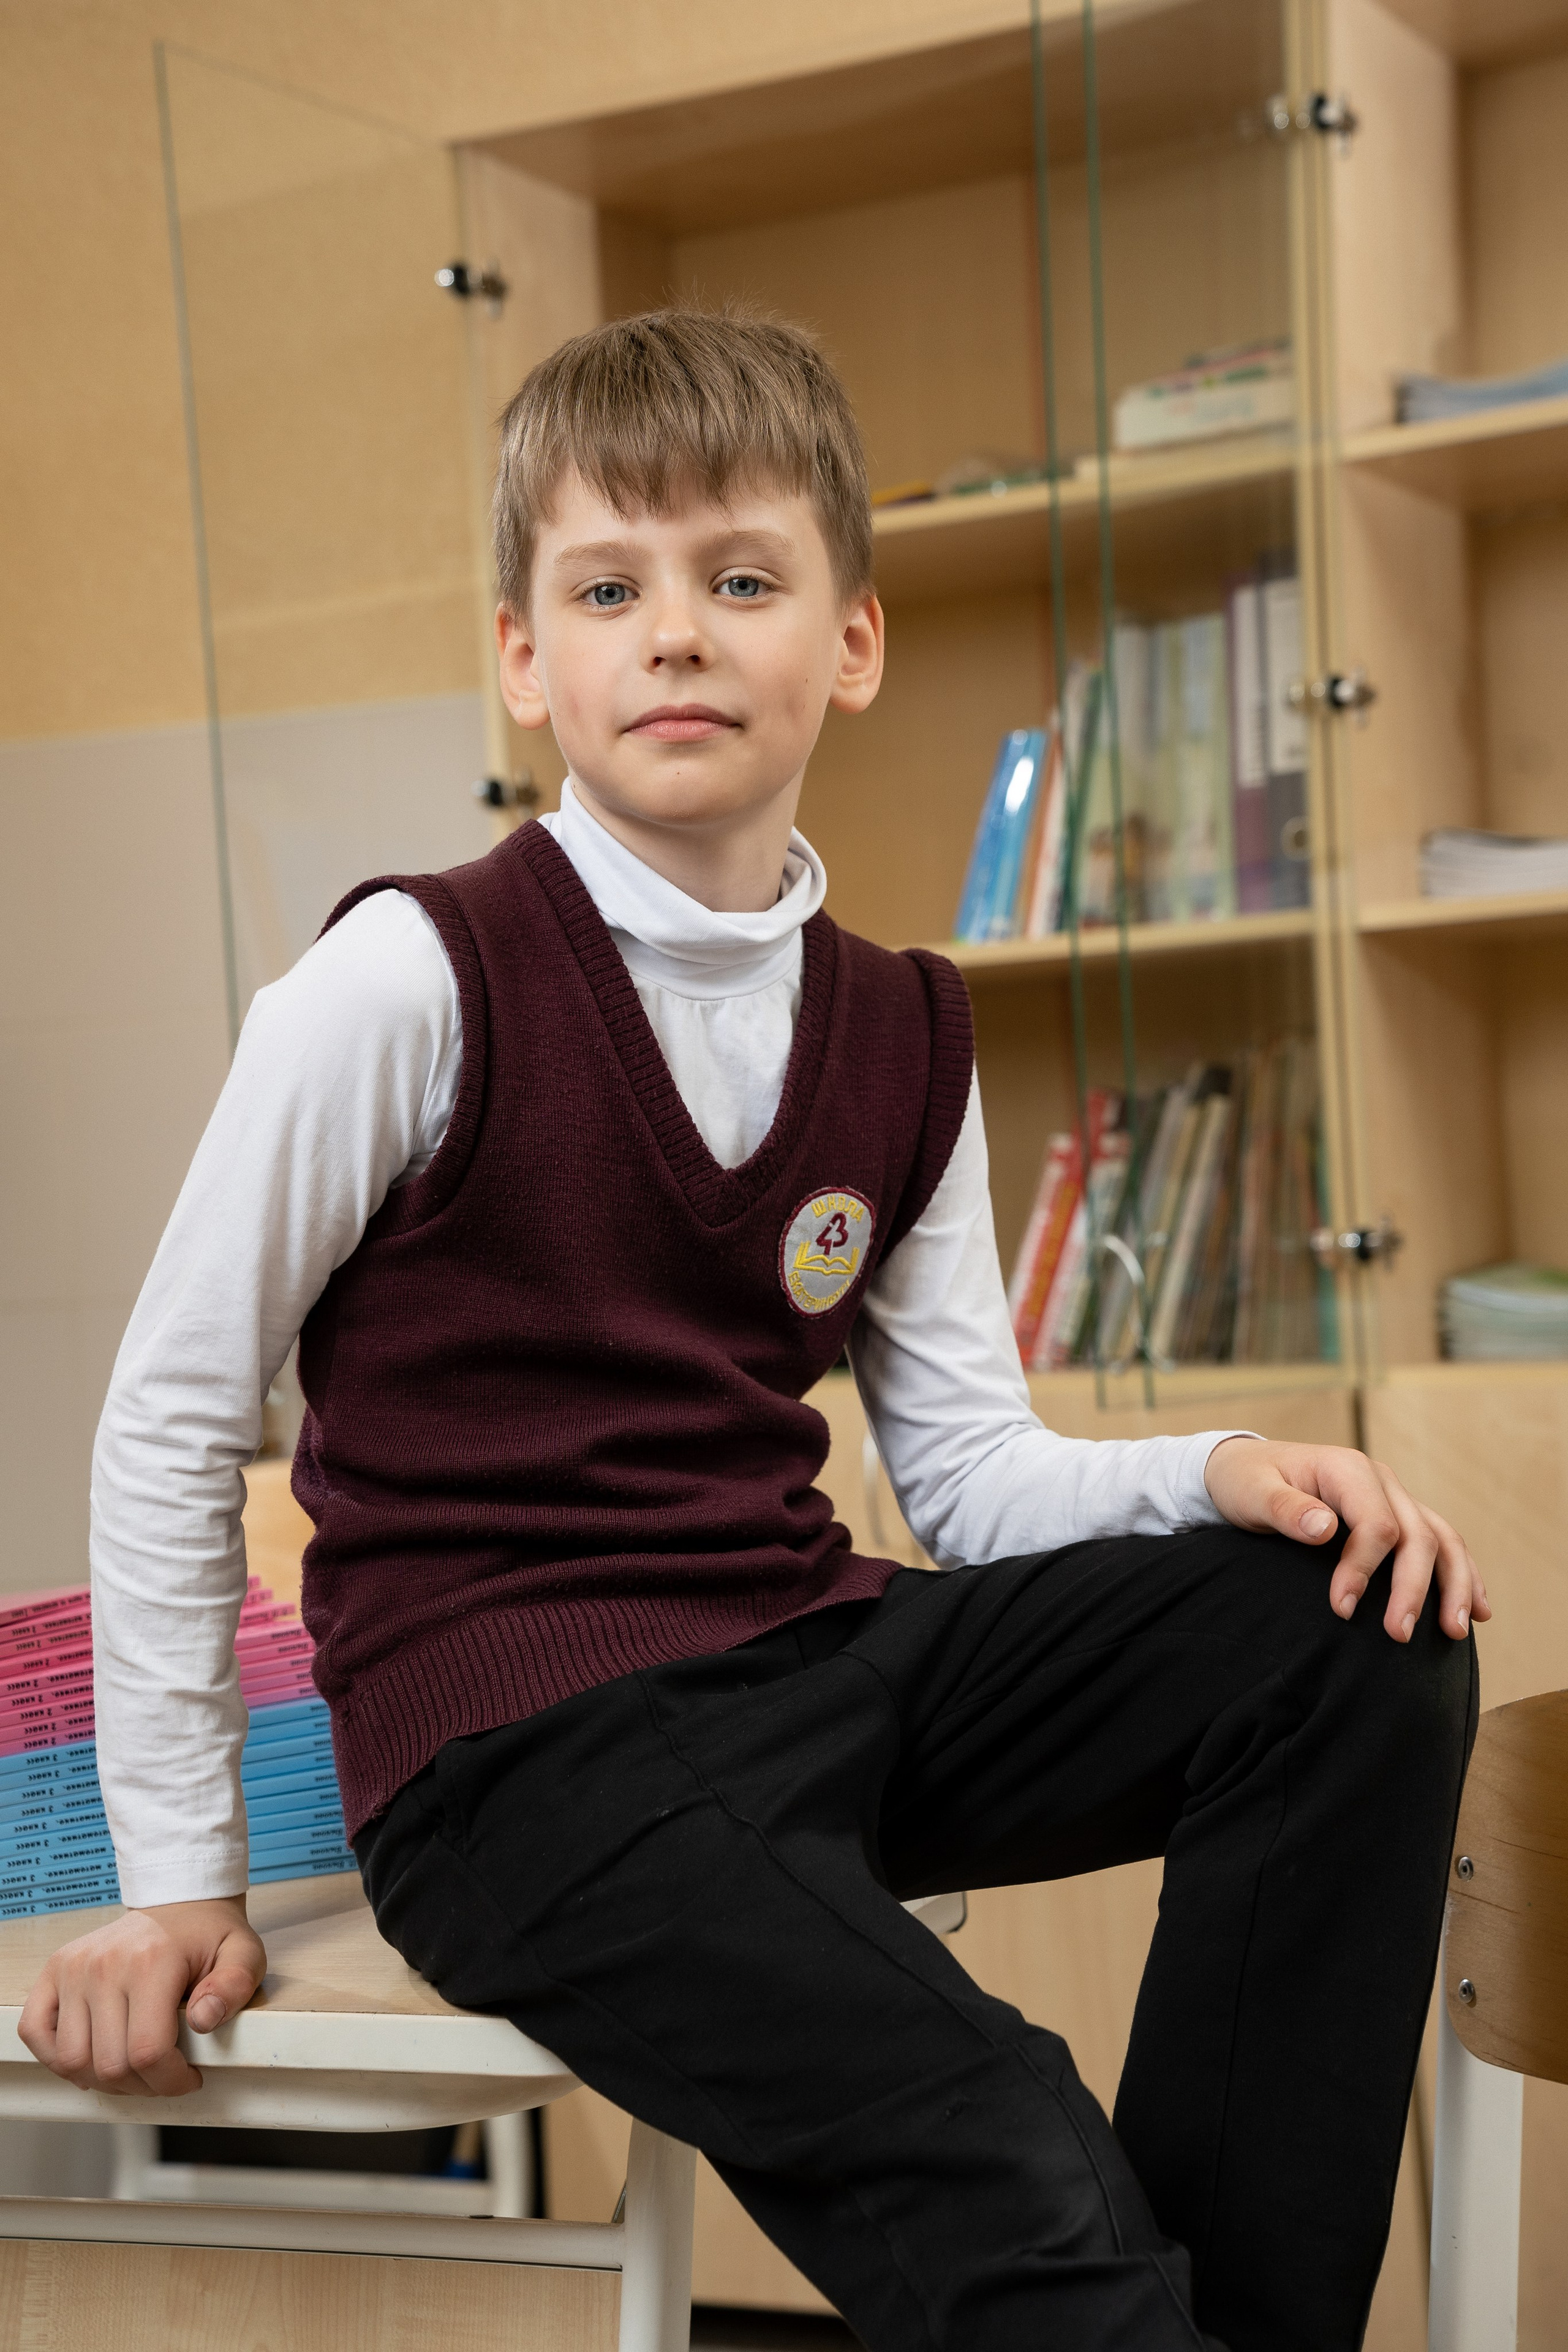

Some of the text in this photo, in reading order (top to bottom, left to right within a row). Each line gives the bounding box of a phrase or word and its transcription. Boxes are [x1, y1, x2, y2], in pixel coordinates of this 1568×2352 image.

[812, 1194, 864, 1222] ШКОЛА
[7, 1681, 31, 1691] класс
[12, 1696, 36, 1706] класс
[21, 1709, 44, 1719] класс
[24, 1724, 48, 1734] класс
[50, 1722, 56, 1732] 2
[24, 1738, 48, 1749] класс
[50, 1737, 57, 1746] 2
[27, 1755, 50, 1765] класс
[29, 1772, 52, 1781] класс
[23, 1790, 46, 1798] класс
[22, 1807, 46, 1816] класс
[58, 1830, 110, 1842] атематике,
